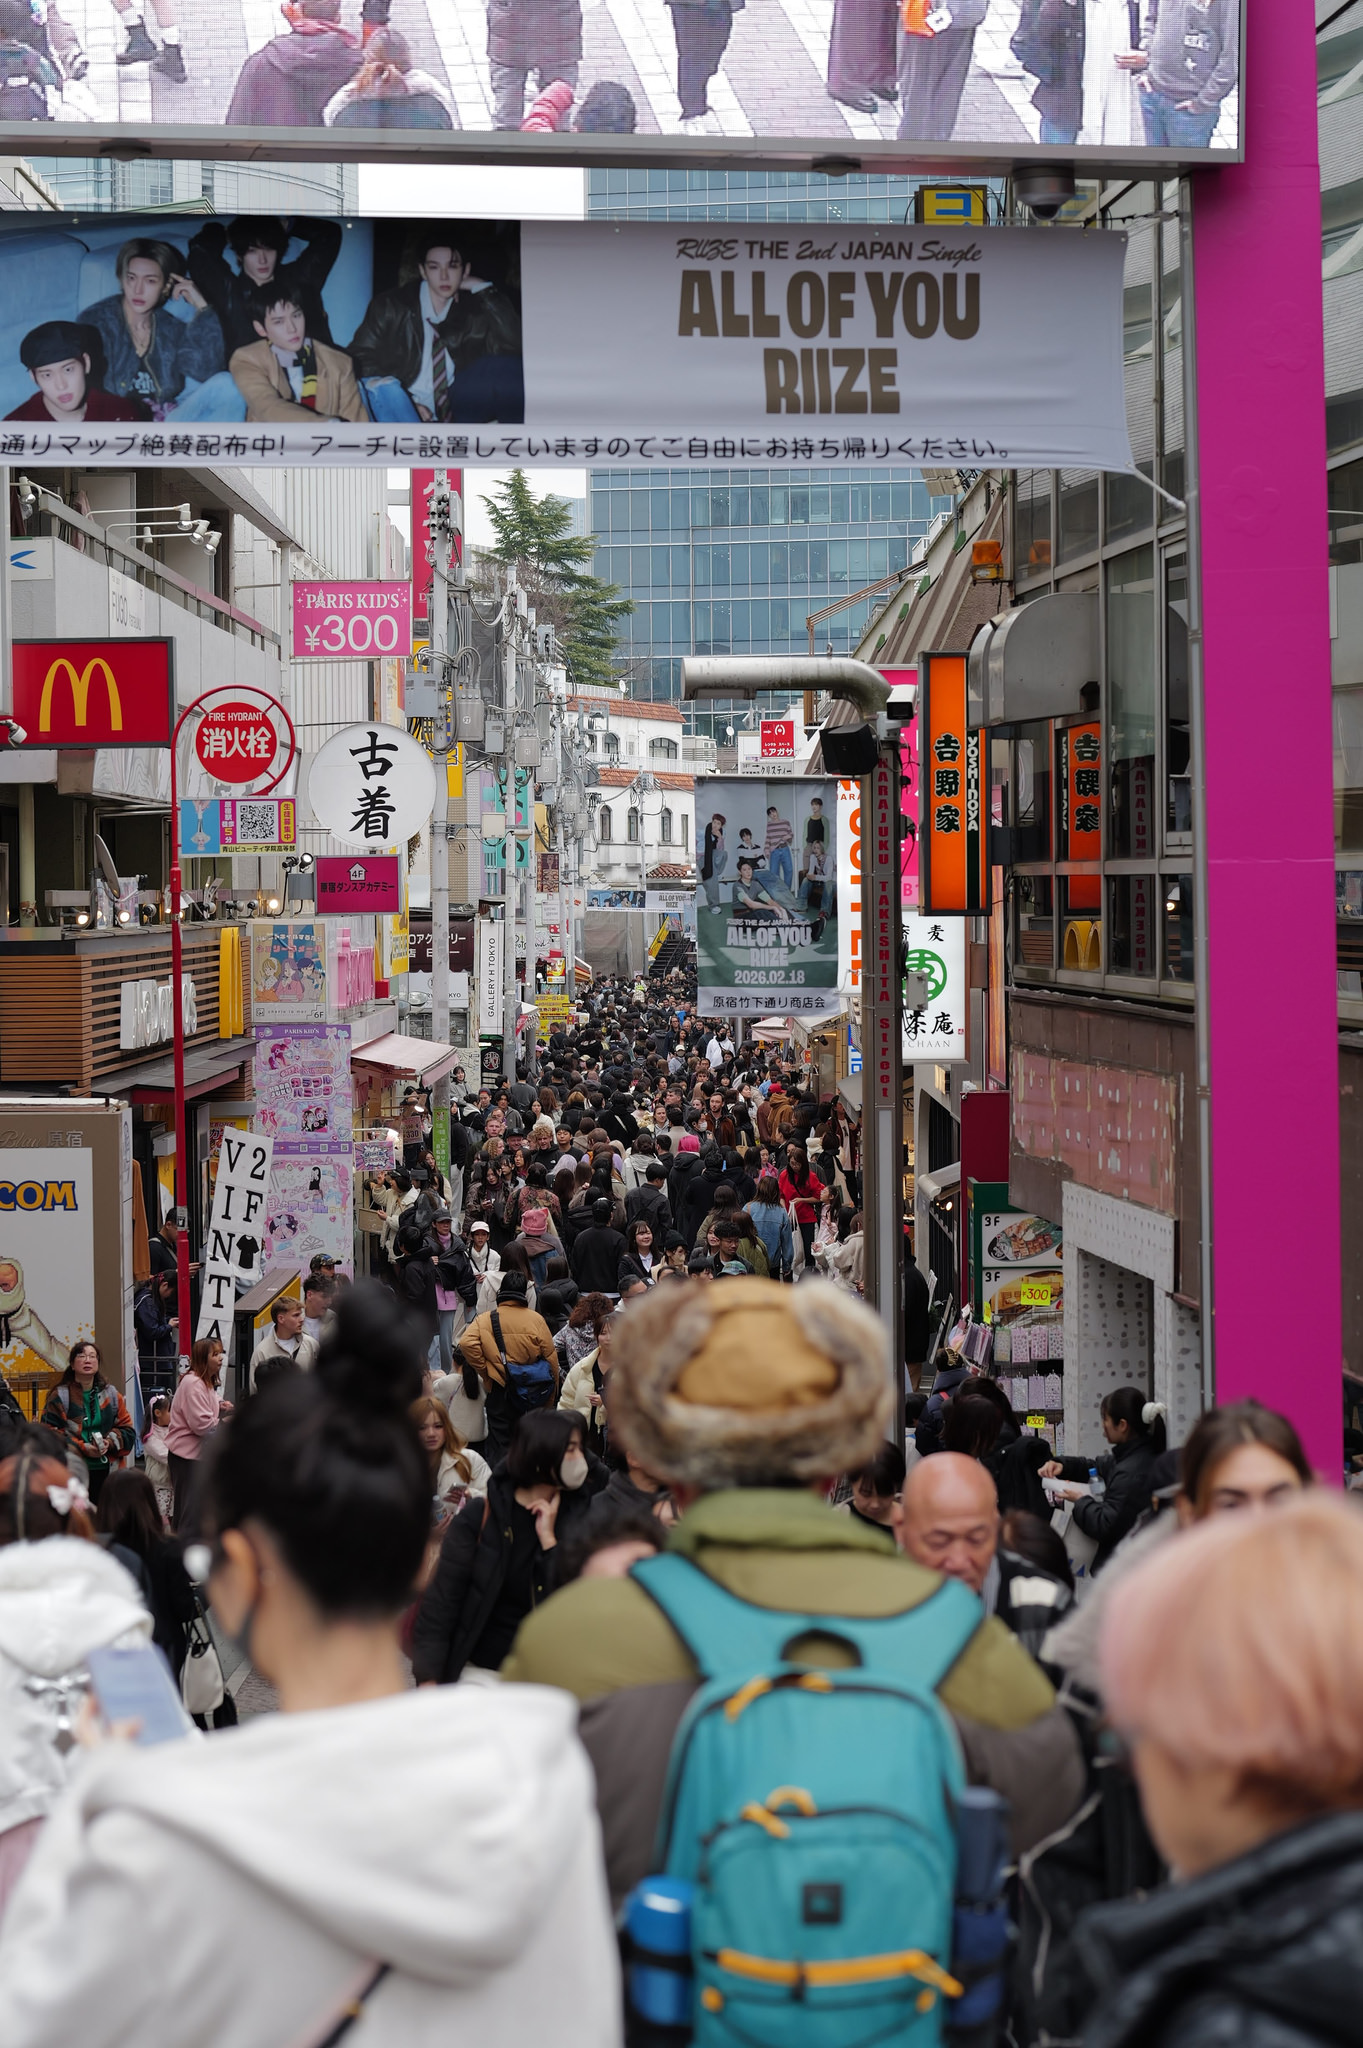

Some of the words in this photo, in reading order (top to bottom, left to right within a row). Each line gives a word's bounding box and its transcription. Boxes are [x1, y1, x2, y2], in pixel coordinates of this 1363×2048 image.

[744, 240, 789, 260] THE
[795, 242, 838, 261] 2nd
[841, 240, 913, 261] JAPAN
[916, 240, 983, 268] Single
[677, 269, 781, 338] ALL
[786, 270, 856, 339] OF
[864, 271, 981, 341] YOU
[763, 347, 900, 415] RIIZE
[305, 588, 354, 609] PARIS
[356, 593, 400, 609] KID'S
[304, 614, 399, 652] ¥300
[208, 711, 226, 722] FIRE
[227, 710, 264, 722] HYDRANT
[202, 726, 272, 760] 消火栓
[768, 748, 794, 756] アガサ
[760, 765, 792, 775] クリスティー
[348, 730, 399, 841] 古着
[877, 758, 889, 865] HARAJUKU
[351, 868, 364, 880] 4F
[319, 880, 396, 895] 原宿ダンスアカデミー
[726, 926, 757, 947] ALL
[756, 926, 777, 948] OF
[777, 926, 812, 948] YOU
[878, 881, 890, 1002] TAKESHITA
[488, 937, 496, 968] TOKYO
[749, 947, 789, 968] RIIZE
[734, 969, 806, 985] 2026.02.18
[487, 978, 496, 1018] GALLERY
[712, 996, 826, 1009] 原宿竹下通り商店会
[313, 1011, 325, 1019] 6F
[879, 1017, 890, 1098] Street
